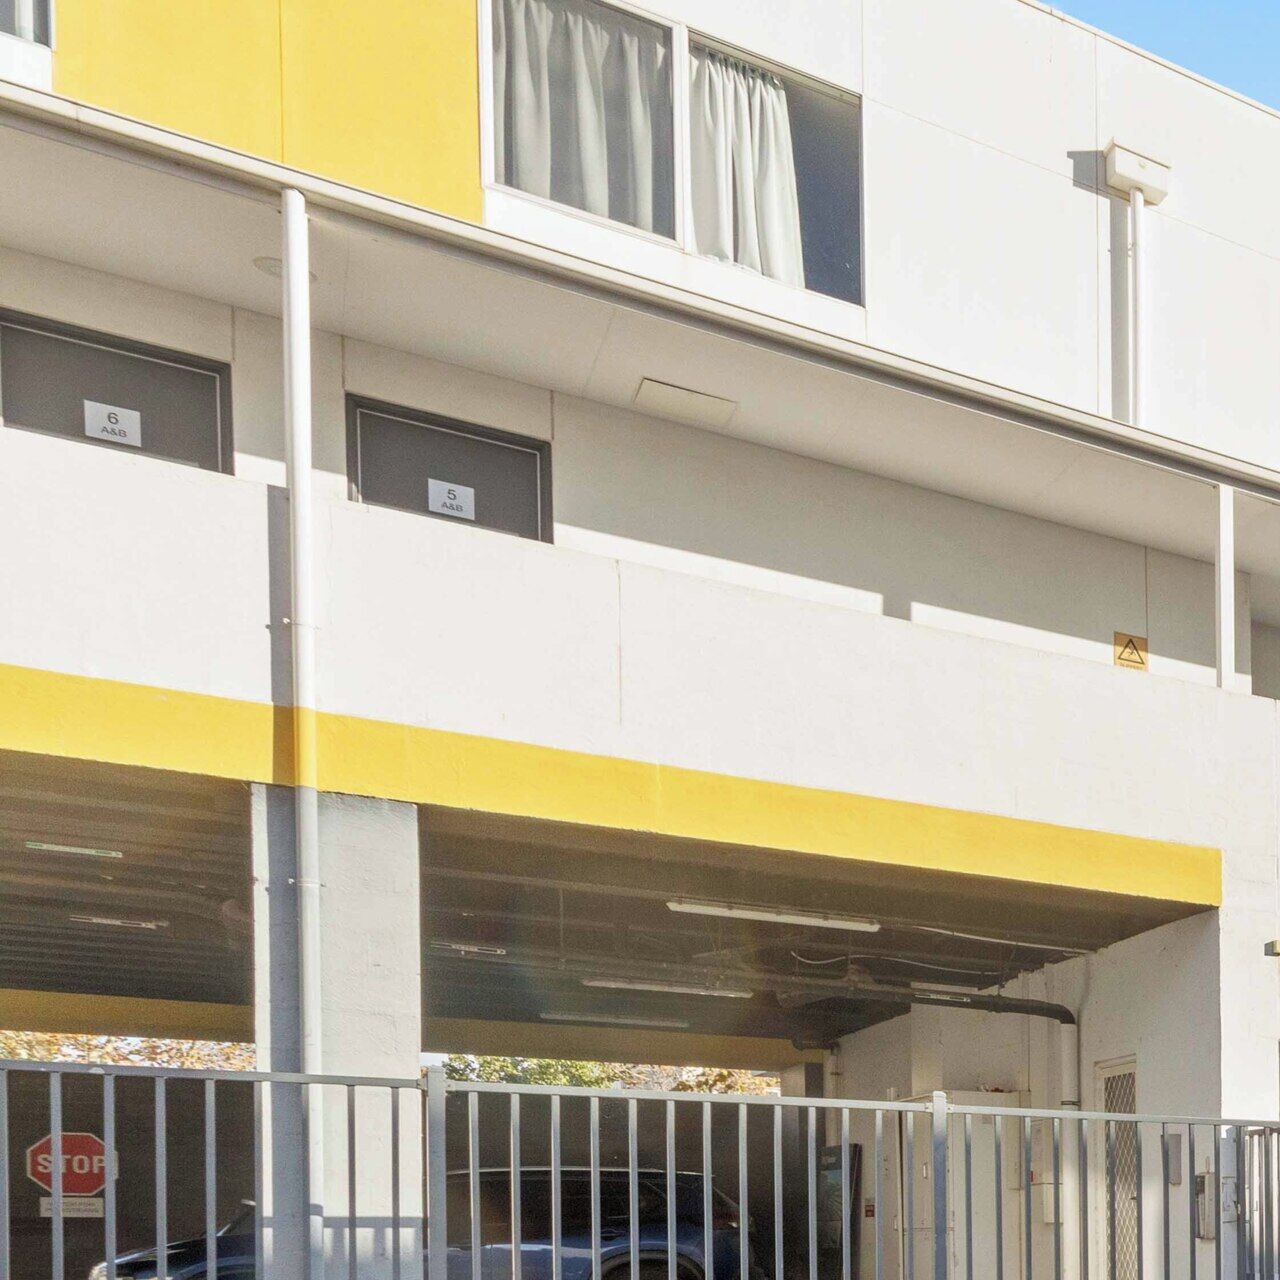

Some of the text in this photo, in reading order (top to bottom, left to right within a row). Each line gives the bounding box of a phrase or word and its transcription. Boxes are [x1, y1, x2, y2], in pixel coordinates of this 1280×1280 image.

[107, 412, 119, 425] 6
[101, 426, 128, 438] A&B
[447, 489, 457, 501] 5
[441, 501, 464, 512] A&B
